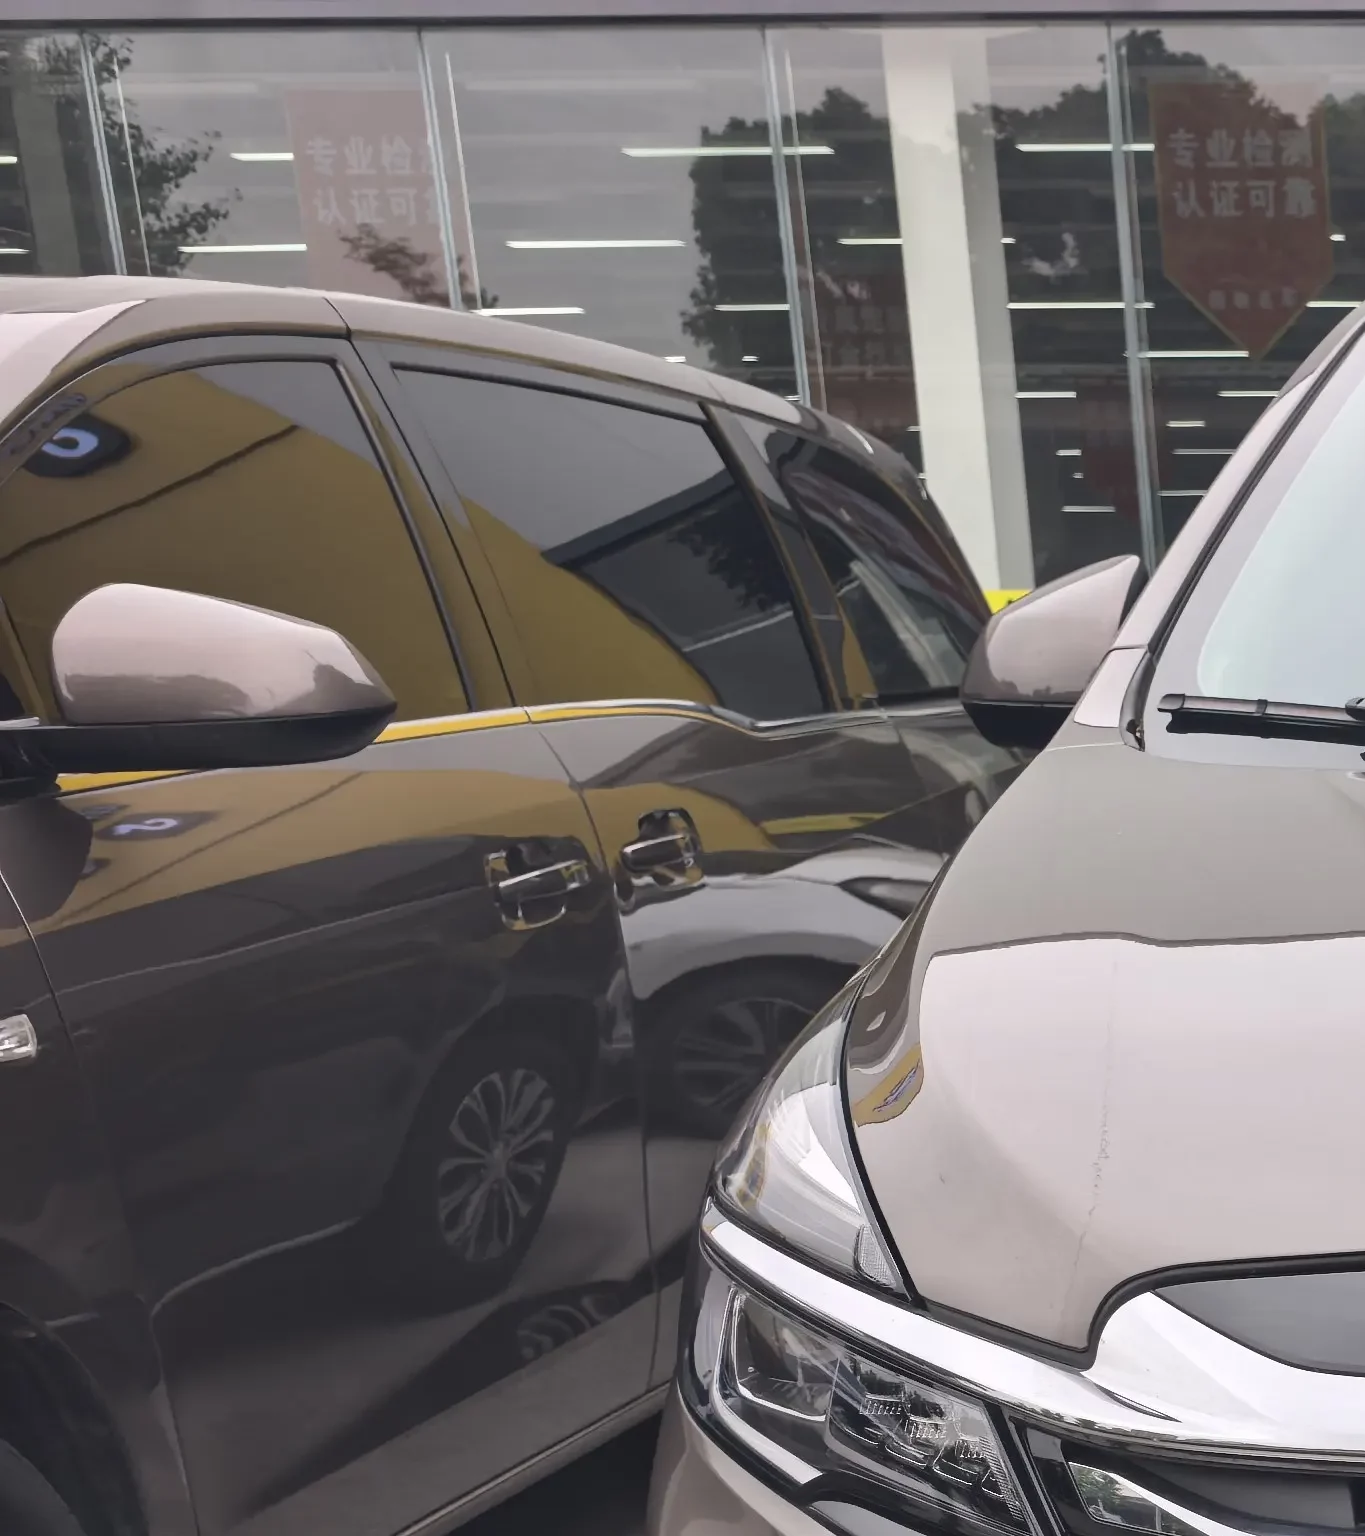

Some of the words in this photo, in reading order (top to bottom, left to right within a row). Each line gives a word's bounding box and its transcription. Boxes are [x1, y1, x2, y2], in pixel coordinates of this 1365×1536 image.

[1166, 126, 1315, 170] 专业检测
[1171, 178, 1319, 221] 认证可靠
